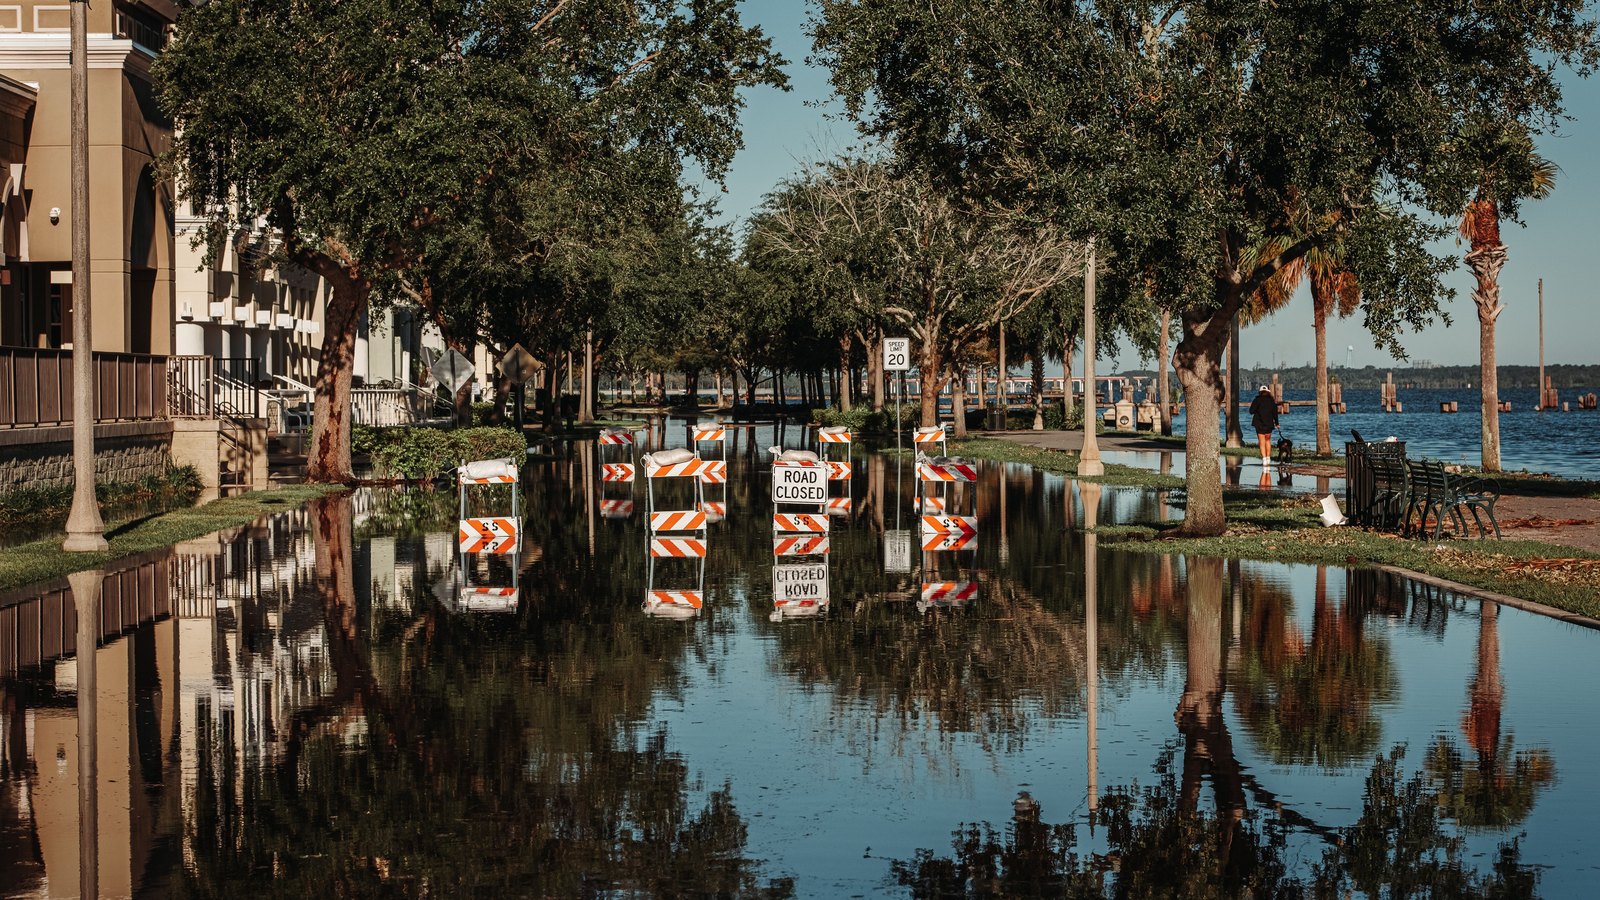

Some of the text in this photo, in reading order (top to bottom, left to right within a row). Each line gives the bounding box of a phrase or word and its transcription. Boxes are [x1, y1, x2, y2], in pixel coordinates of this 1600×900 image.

[888, 353, 905, 366] 20
[784, 470, 817, 484] ROAD
[776, 486, 824, 500] CLOSED
